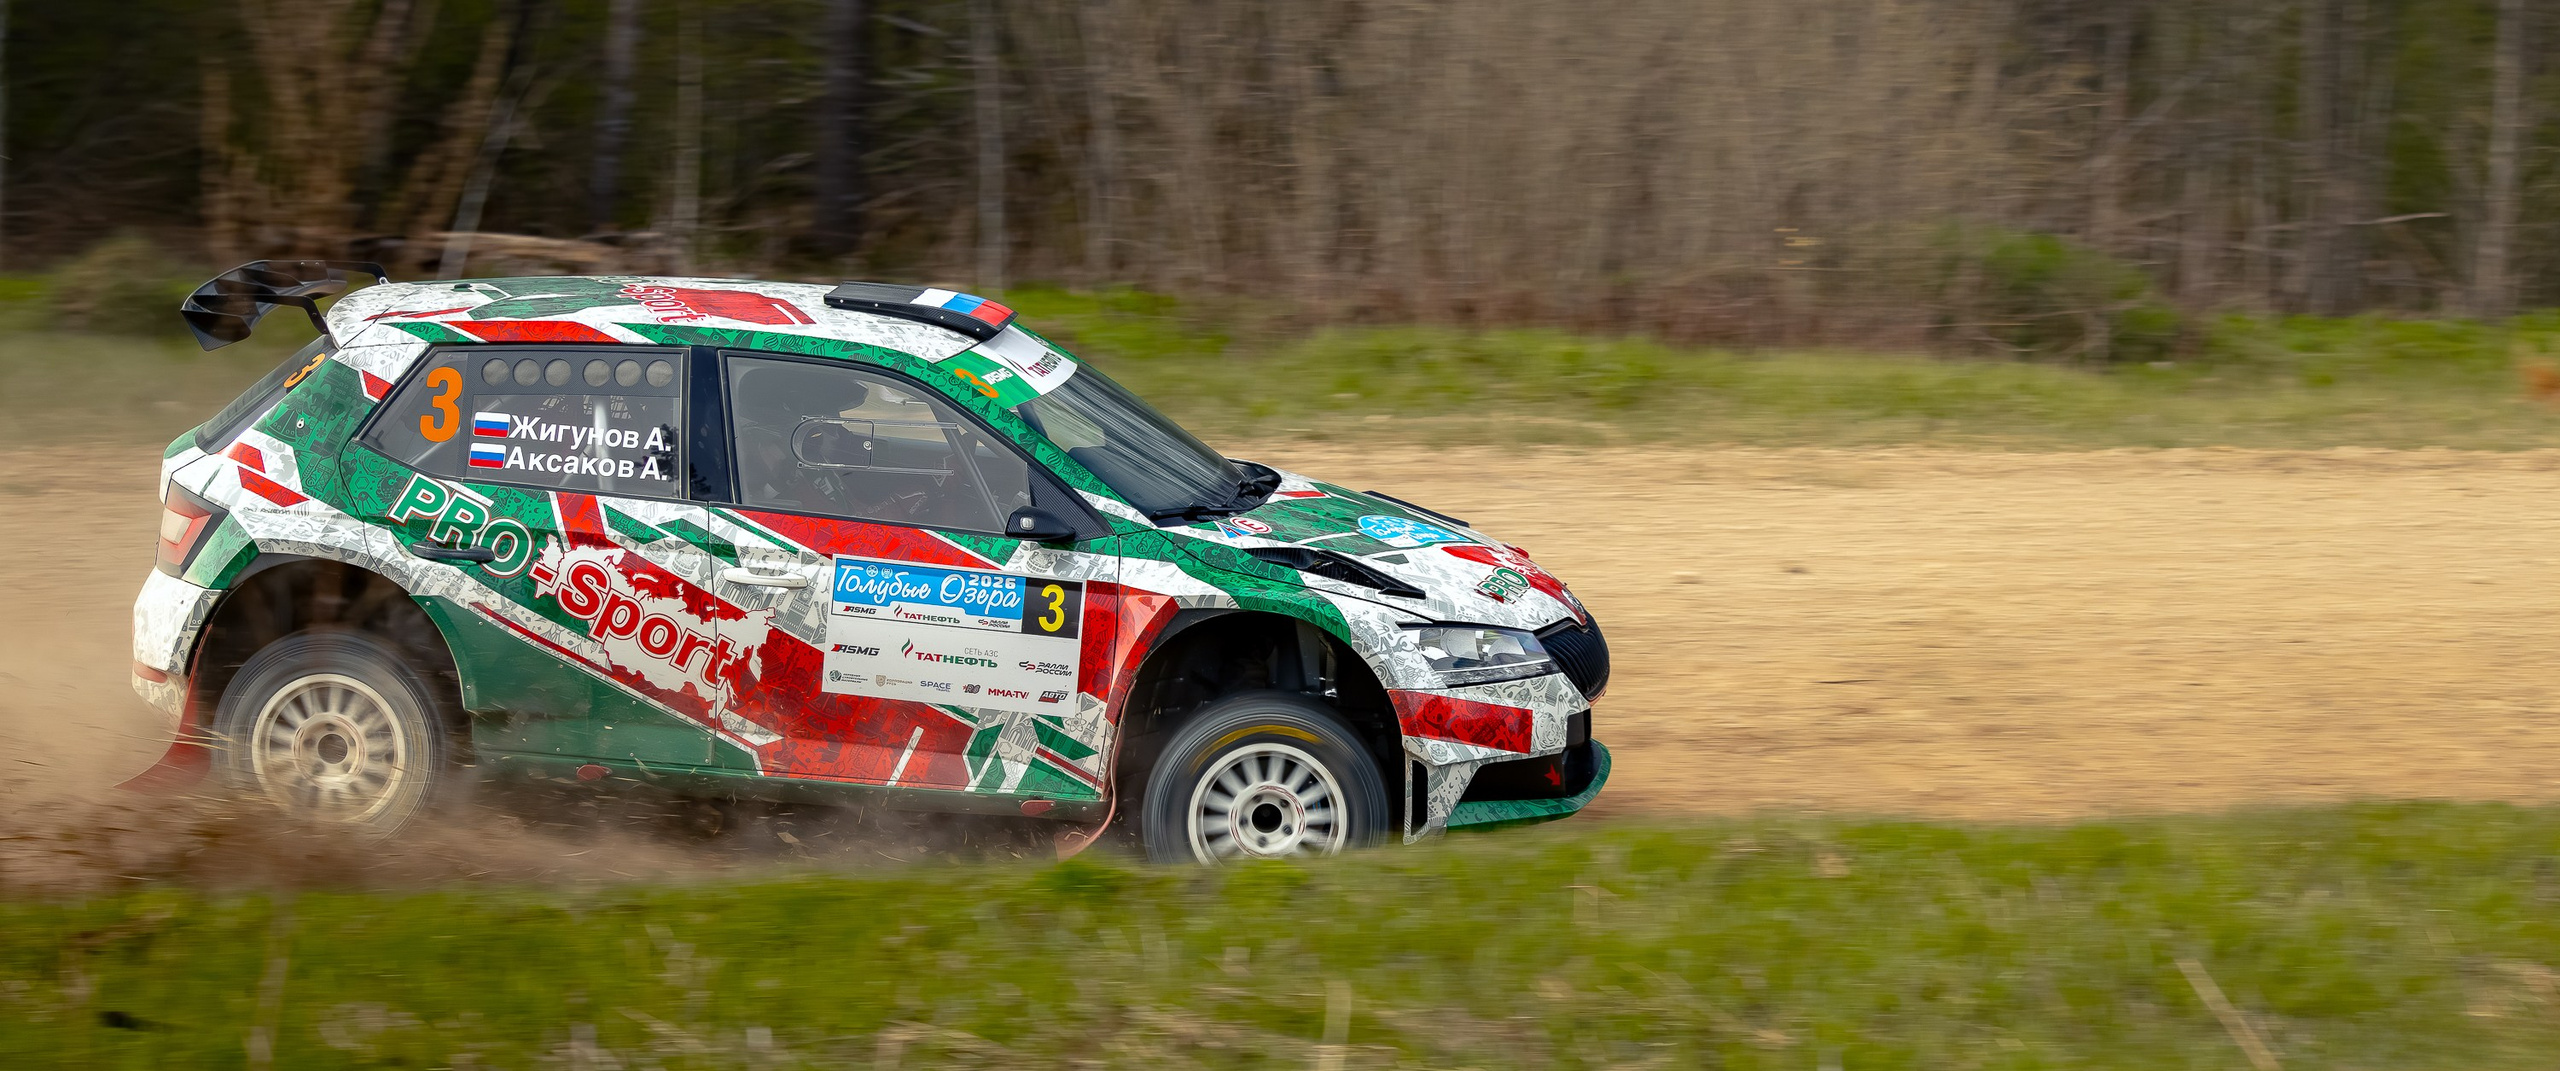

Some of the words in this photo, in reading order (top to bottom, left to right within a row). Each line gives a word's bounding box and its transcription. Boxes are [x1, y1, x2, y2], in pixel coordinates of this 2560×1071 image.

[283, 353, 326, 388] 3
[954, 368, 999, 398] 3
[419, 366, 463, 443] 3
[508, 414, 639, 451] Жигунов
[643, 427, 672, 452] А.
[504, 446, 635, 478] Аксаков
[639, 457, 668, 481] А.
[836, 565, 931, 604] Голубые
[940, 574, 1021, 615] Озера
[968, 574, 1016, 590] 2026
[903, 612, 960, 624] ТАТНЕФТЬ
[1038, 584, 1065, 632] 3
[915, 651, 998, 668] ТАТНЕФТЬ
[964, 647, 983, 656] СЕТЬ
[984, 649, 999, 658] АЗС
[920, 680, 951, 690] SPACE
